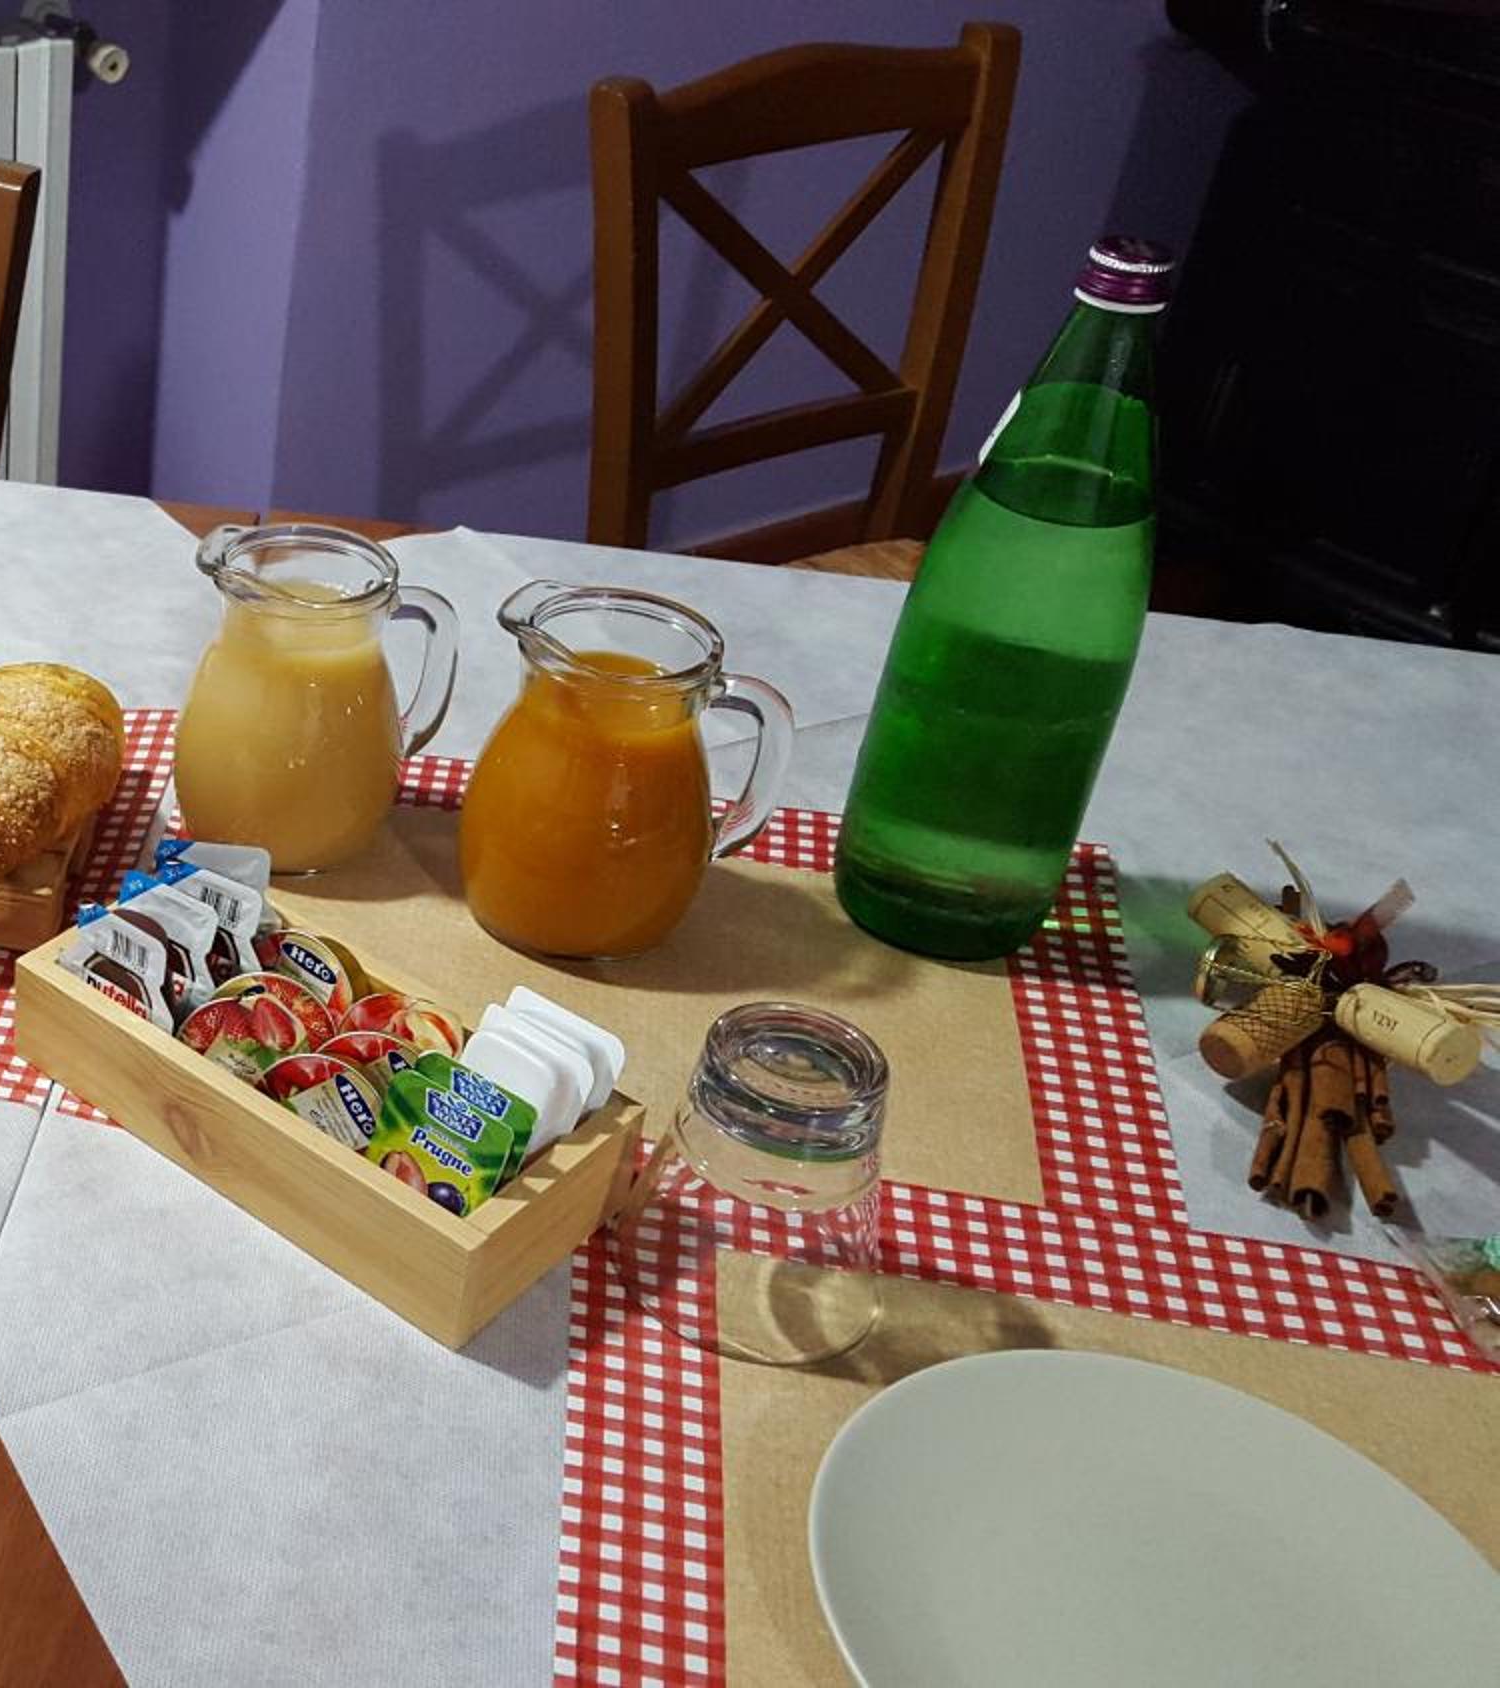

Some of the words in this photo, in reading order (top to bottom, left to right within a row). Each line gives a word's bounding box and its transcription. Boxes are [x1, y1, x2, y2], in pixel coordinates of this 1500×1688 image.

[290, 945, 332, 981] Hero
[339, 1083, 374, 1135] Hero
[411, 1127, 473, 1177] Prugne
